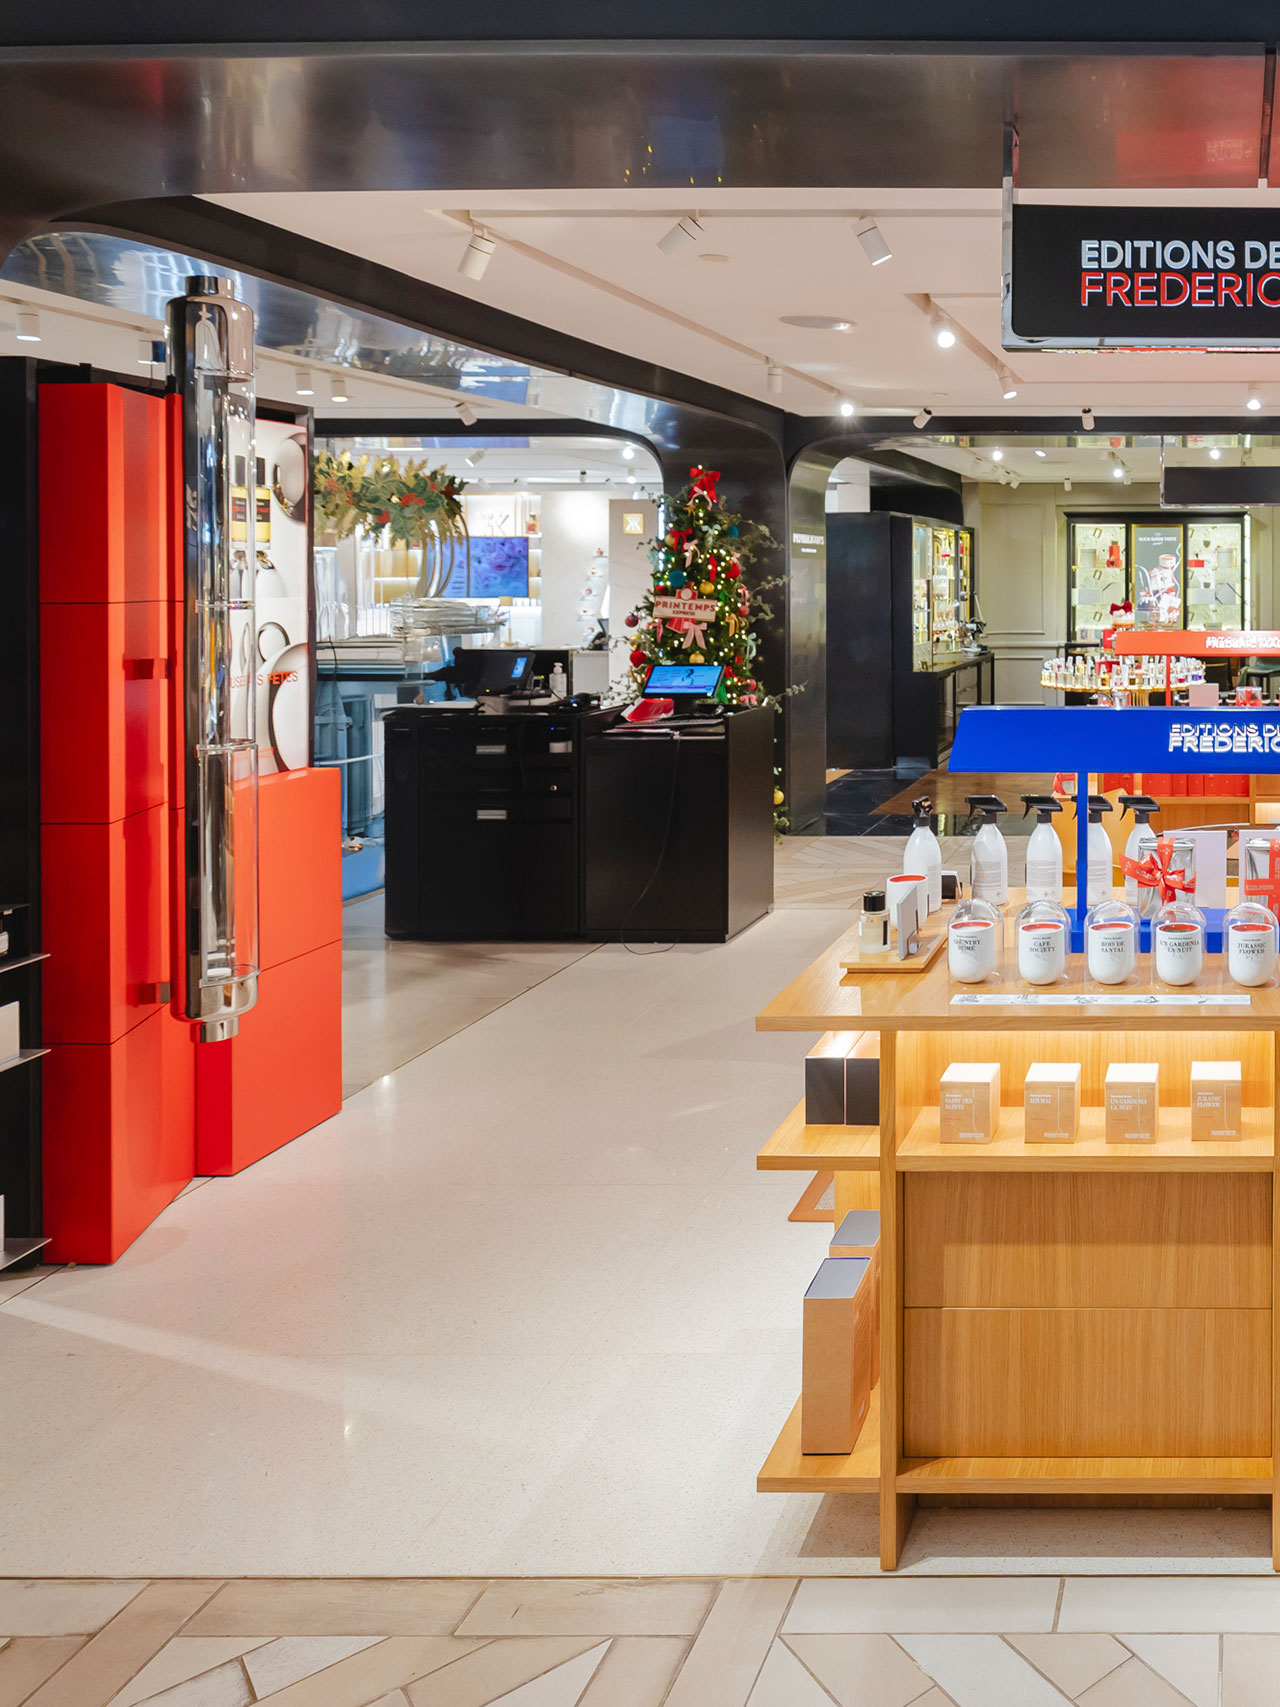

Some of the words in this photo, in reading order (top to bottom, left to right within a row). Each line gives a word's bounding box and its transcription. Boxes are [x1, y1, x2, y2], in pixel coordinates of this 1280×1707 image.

[1081, 240, 1236, 270] EDITIONS
[655, 600, 716, 612] PRINTEMPS
[267, 669, 298, 685] FÊTES
[1170, 723, 1258, 737] EDITIONS
[1168, 940, 1200, 948] GARDENIA
